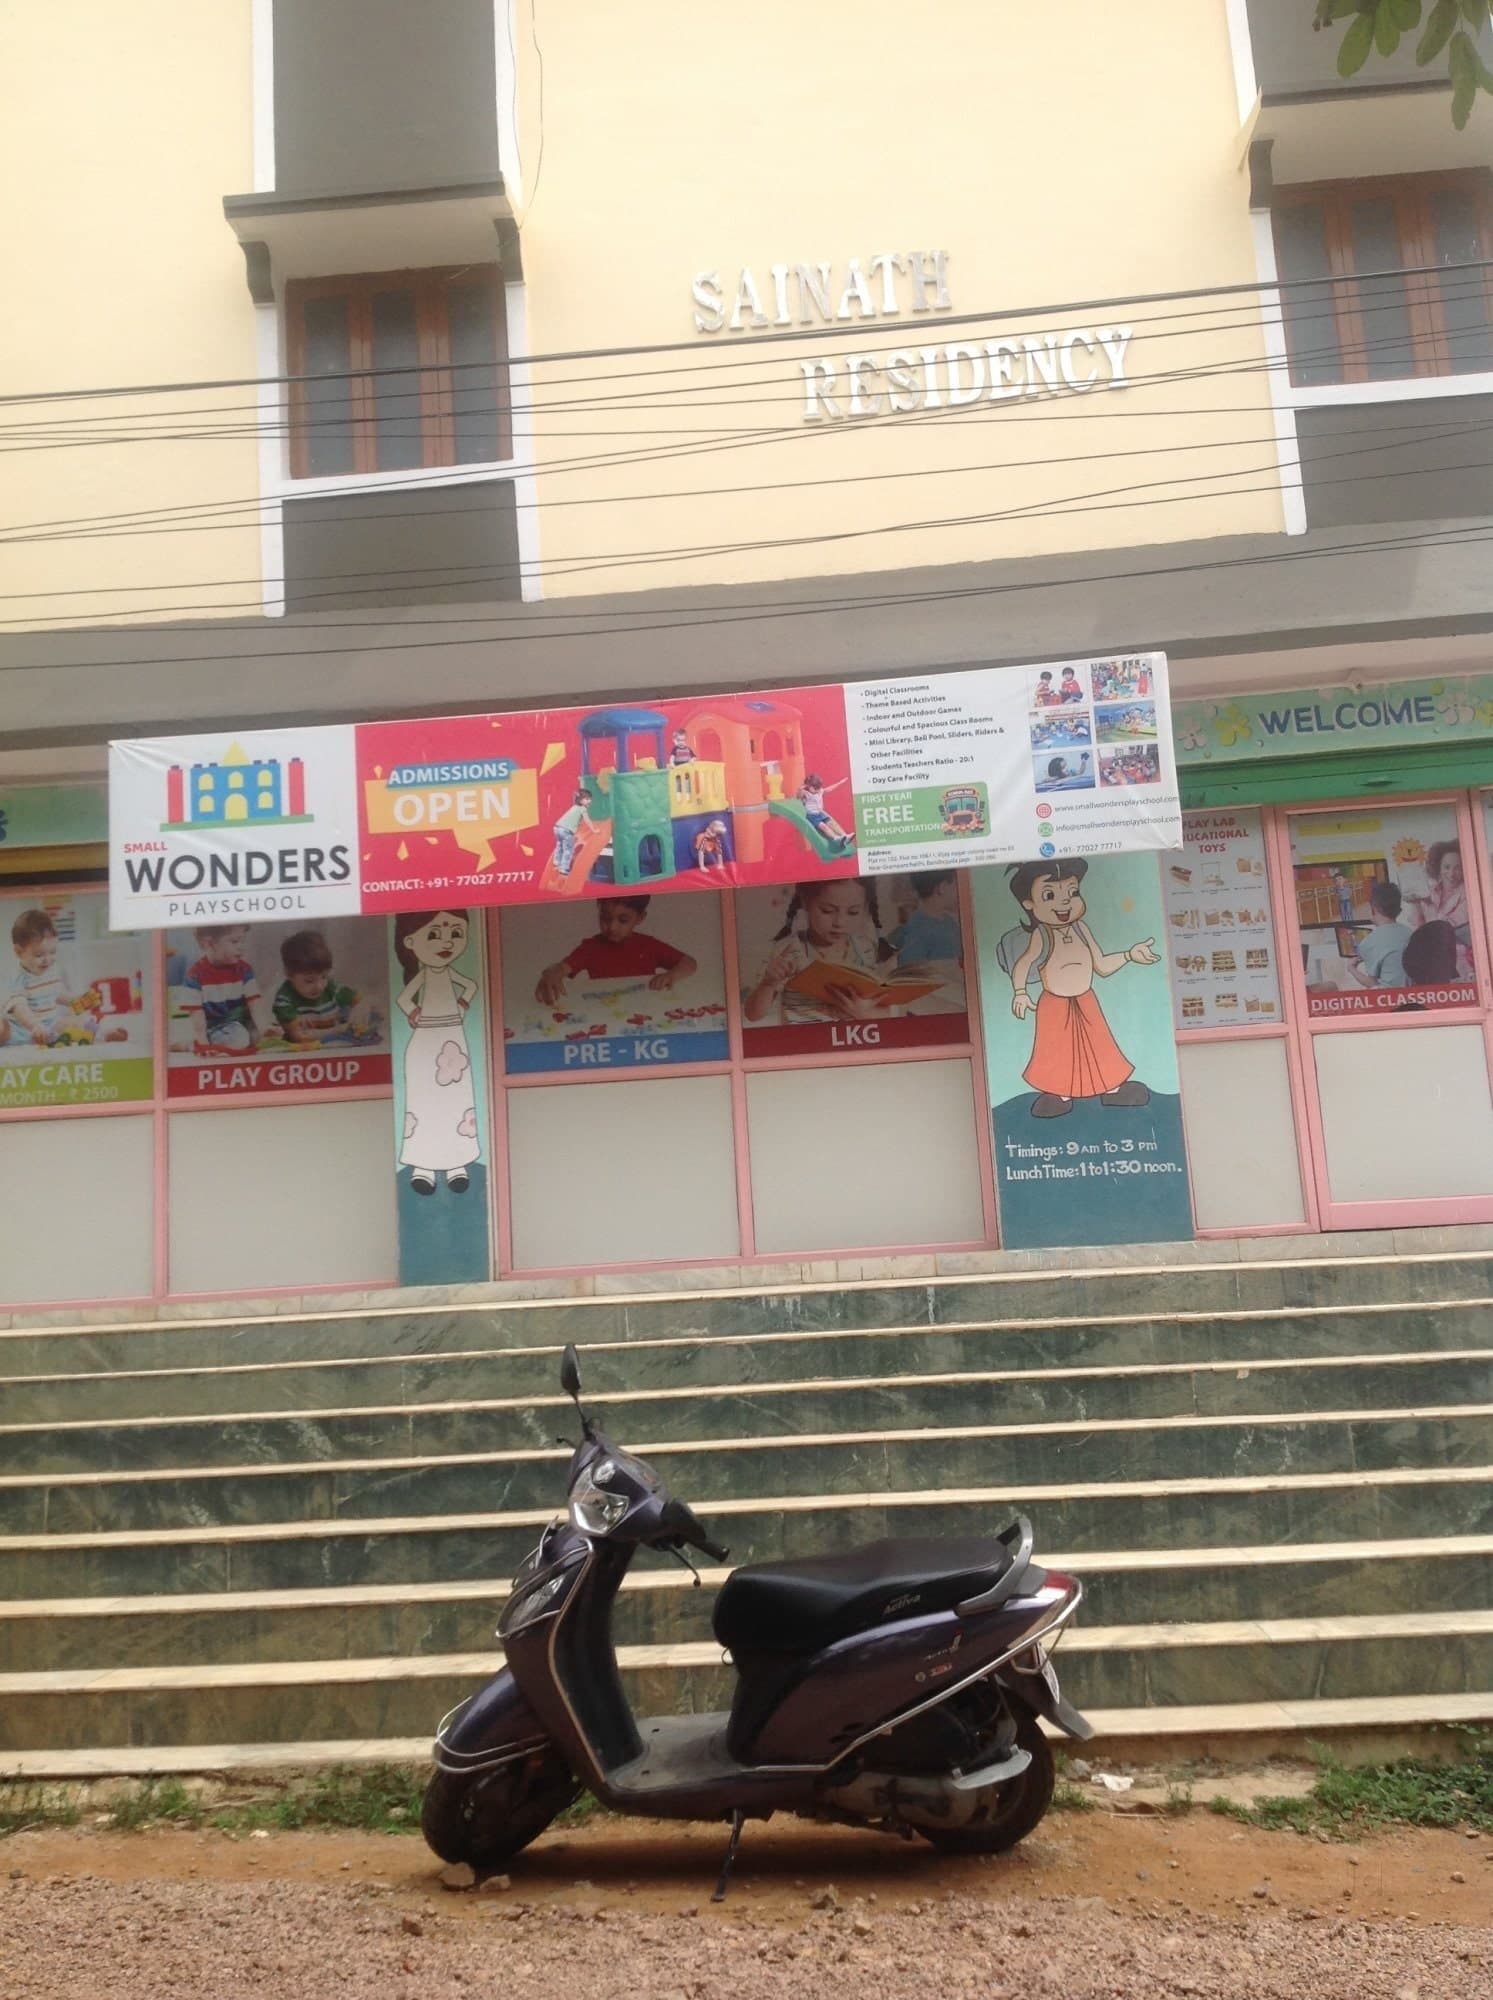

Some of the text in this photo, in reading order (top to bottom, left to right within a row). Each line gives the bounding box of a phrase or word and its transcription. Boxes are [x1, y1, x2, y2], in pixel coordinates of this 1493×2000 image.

[692, 250, 952, 333] SAINATH
[801, 326, 1134, 422] RESIDENCY
[864, 684, 930, 698] Digital Classrooms
[866, 696, 946, 710] Theme Based Activities
[866, 706, 962, 721] Indoor and Outdoor Games
[1258, 696, 1435, 735] WELCOME
[868, 716, 993, 734] Colourful and Spacious Class Rooms
[869, 738, 885, 746] Mini
[975, 728, 997, 736] Riders
[999, 726, 1005, 734] &
[870, 748, 923, 759] Other Facilities
[388, 762, 509, 785] ADMISSIONS
[871, 762, 902, 771] Students
[904, 760, 934, 769] Teachers
[935, 757, 954, 765] Ratio
[872, 772, 930, 785] Day Care Facility
[393, 788, 511, 826] OPEN
[861, 792, 912, 804] FIRST YEAR
[862, 805, 915, 825] FREE
[1213, 816, 1236, 827] LAB
[864, 823, 941, 837] TRANSPORTATION
[123, 841, 168, 853] SMALL
[1076, 844, 1098, 852] 77027
[1100, 842, 1122, 850] 77717
[1199, 843, 1226, 853] TOYS
[124, 845, 350, 893] WONDERS
[362, 878, 424, 893] CONTACT:
[456, 874, 493, 886] 77027
[497, 871, 534, 883] 77717
[169, 896, 306, 916] PLAYSCHOOL
[1310, 988, 1475, 1012] DIGITAL CLASSROOM
[831, 1023, 881, 1046] LKG
[564, 1042, 611, 1065] PRE
[634, 1039, 669, 1060] KG
[38, 1063, 104, 1086] CARE
[198, 1061, 361, 1090] PLAY GROUP
[83, 1086, 119, 1100] 2500
[1005, 1143, 1064, 1161] Timings:
[1103, 1140, 1118, 1153] to
[1120, 1139, 1134, 1152] 3
[1143, 1161, 1182, 1174] noon.
